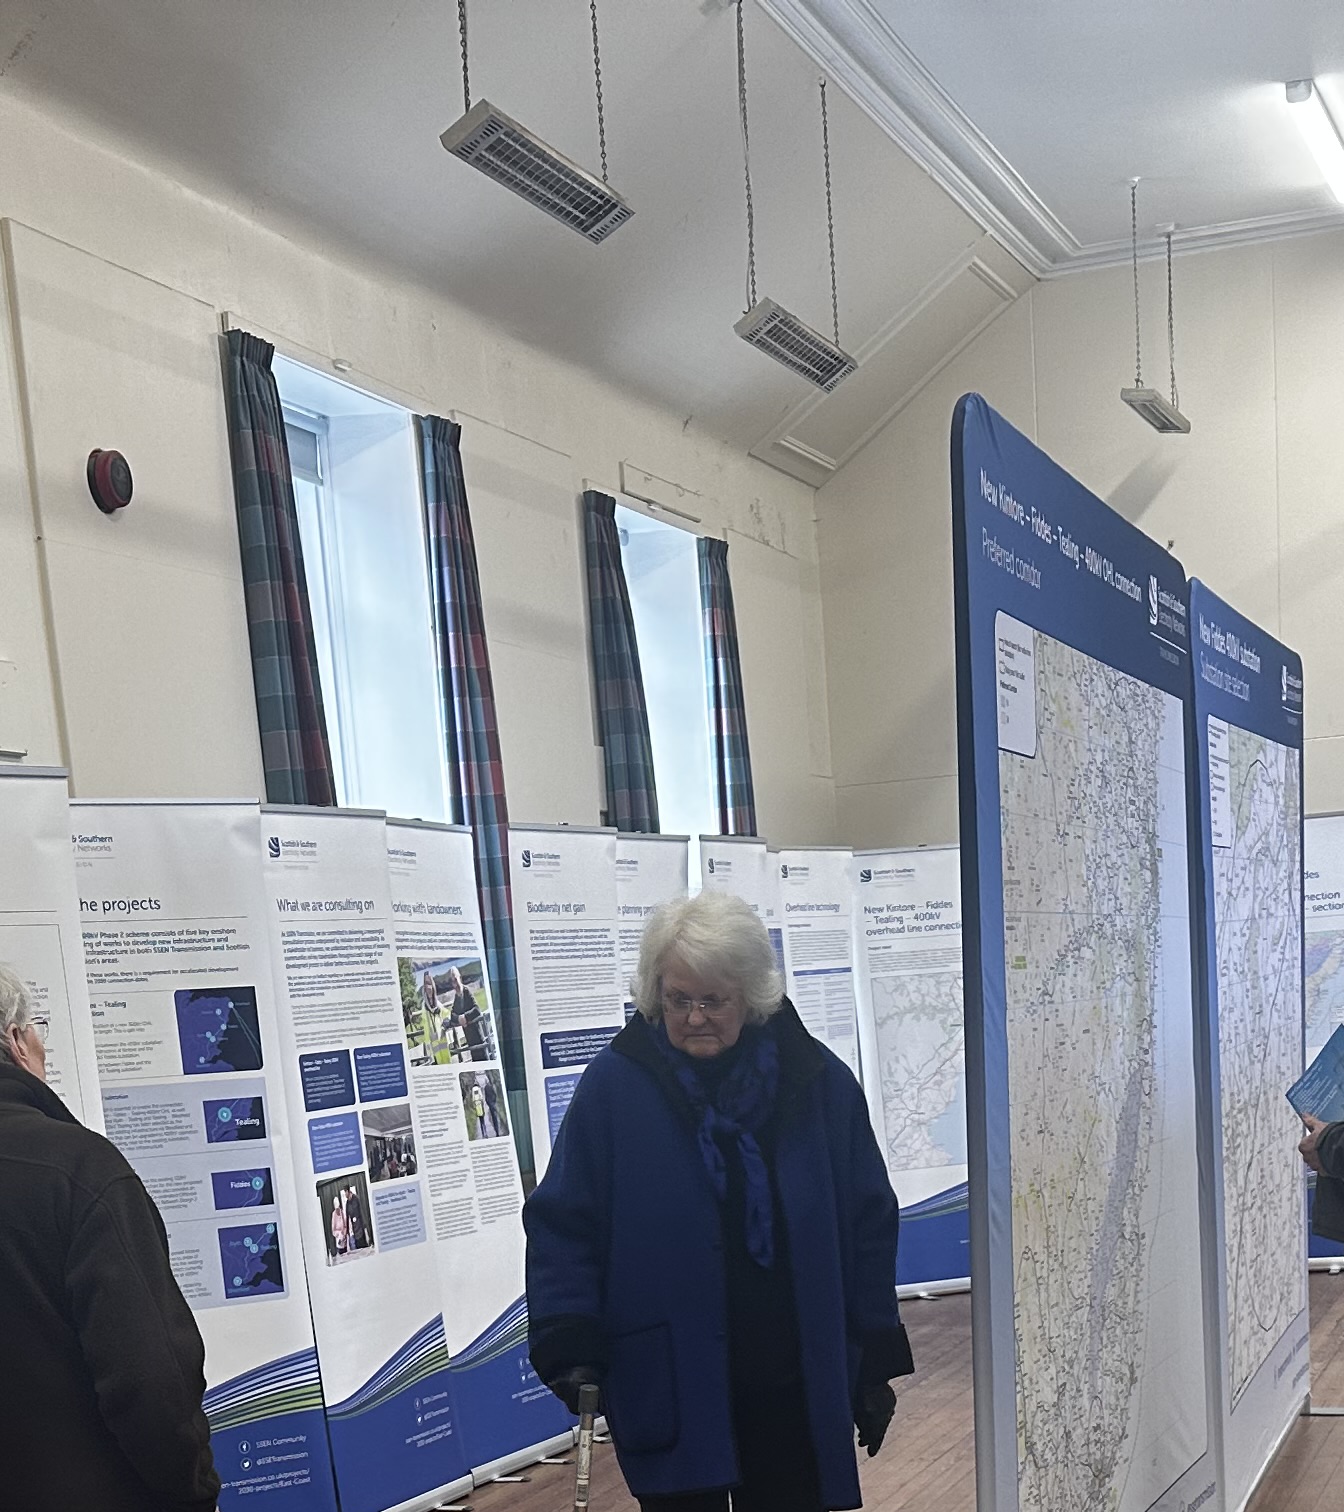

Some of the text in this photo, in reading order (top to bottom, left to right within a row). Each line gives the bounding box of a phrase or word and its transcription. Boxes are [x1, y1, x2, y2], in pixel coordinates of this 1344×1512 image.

[980, 467, 1142, 602] New Kintore Fiddes Tealing 400kV OHL connection
[982, 527, 1041, 590] Preferred corridor
[79, 897, 160, 914] he projects
[276, 898, 374, 914] What we are consulting on
[412, 902, 462, 915] with landowners
[526, 901, 585, 915] Biodiversity net gain
[864, 900, 953, 914] New Kintore Fiddes
[873, 912, 940, 924] Tealing 400kV
[866, 922, 960, 936] overhead line connecti
[235, 1117, 260, 1127] Tealing
